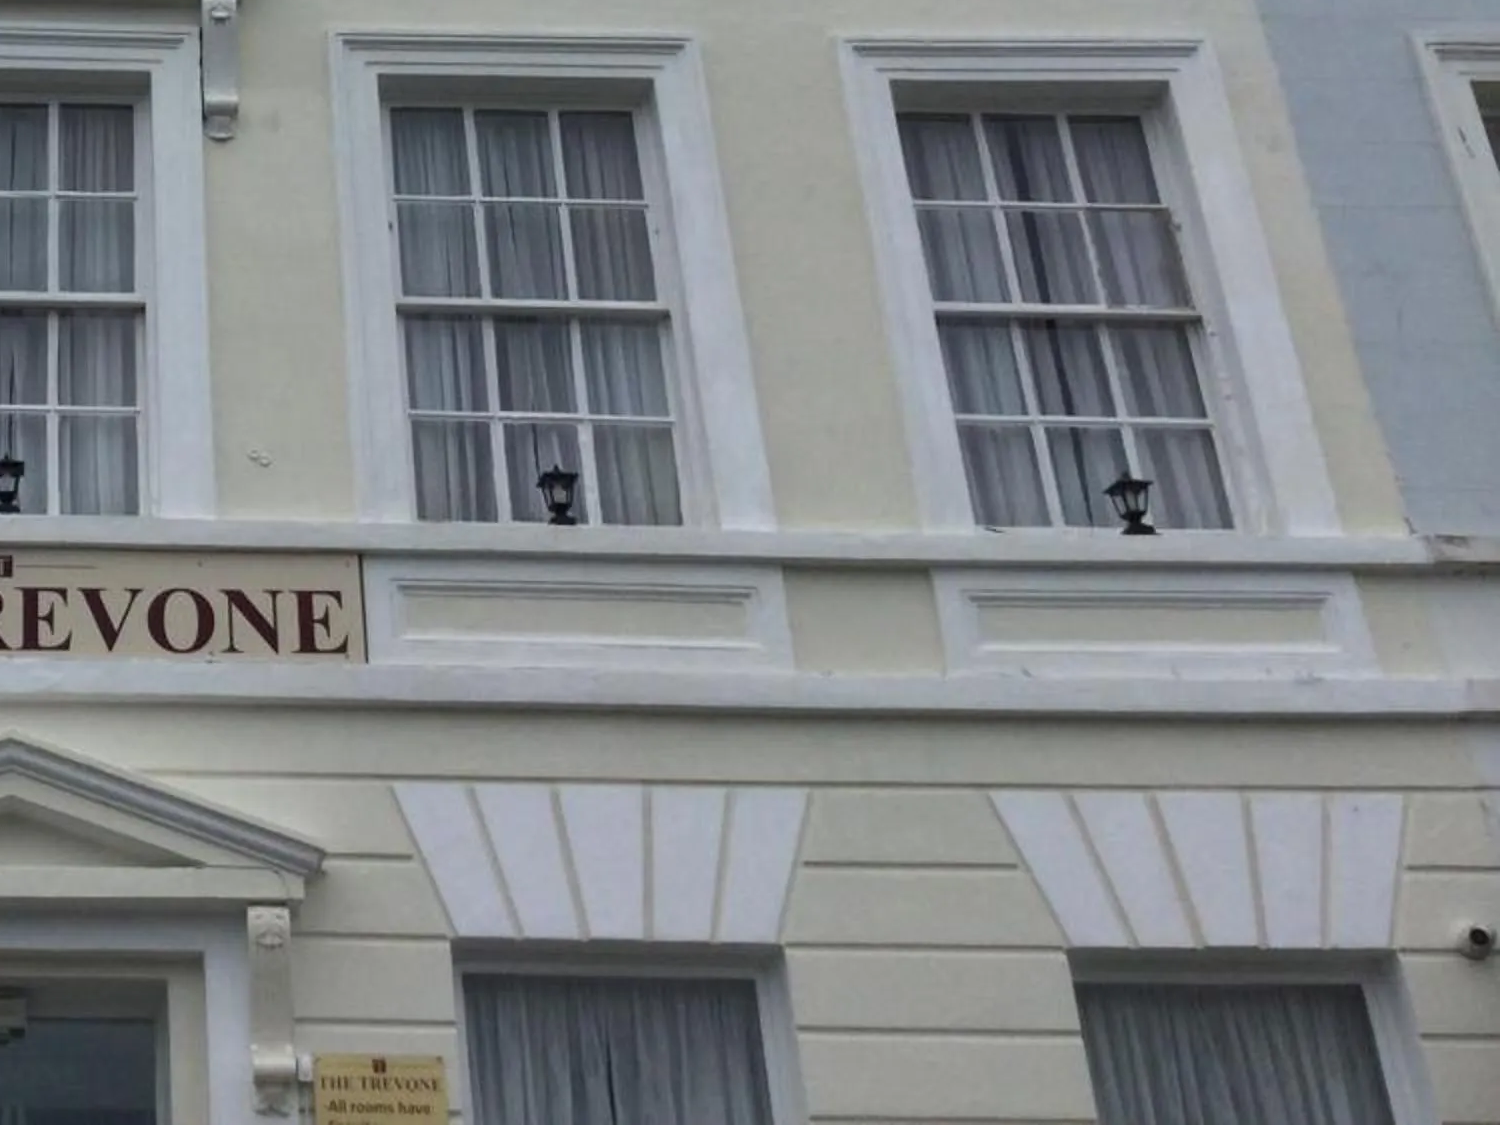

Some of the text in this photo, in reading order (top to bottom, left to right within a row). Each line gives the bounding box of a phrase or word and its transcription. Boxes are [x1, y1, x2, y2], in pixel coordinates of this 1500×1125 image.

[320, 1075, 438, 1093] THE TREVONE
[327, 1099, 431, 1115] All rooms have
